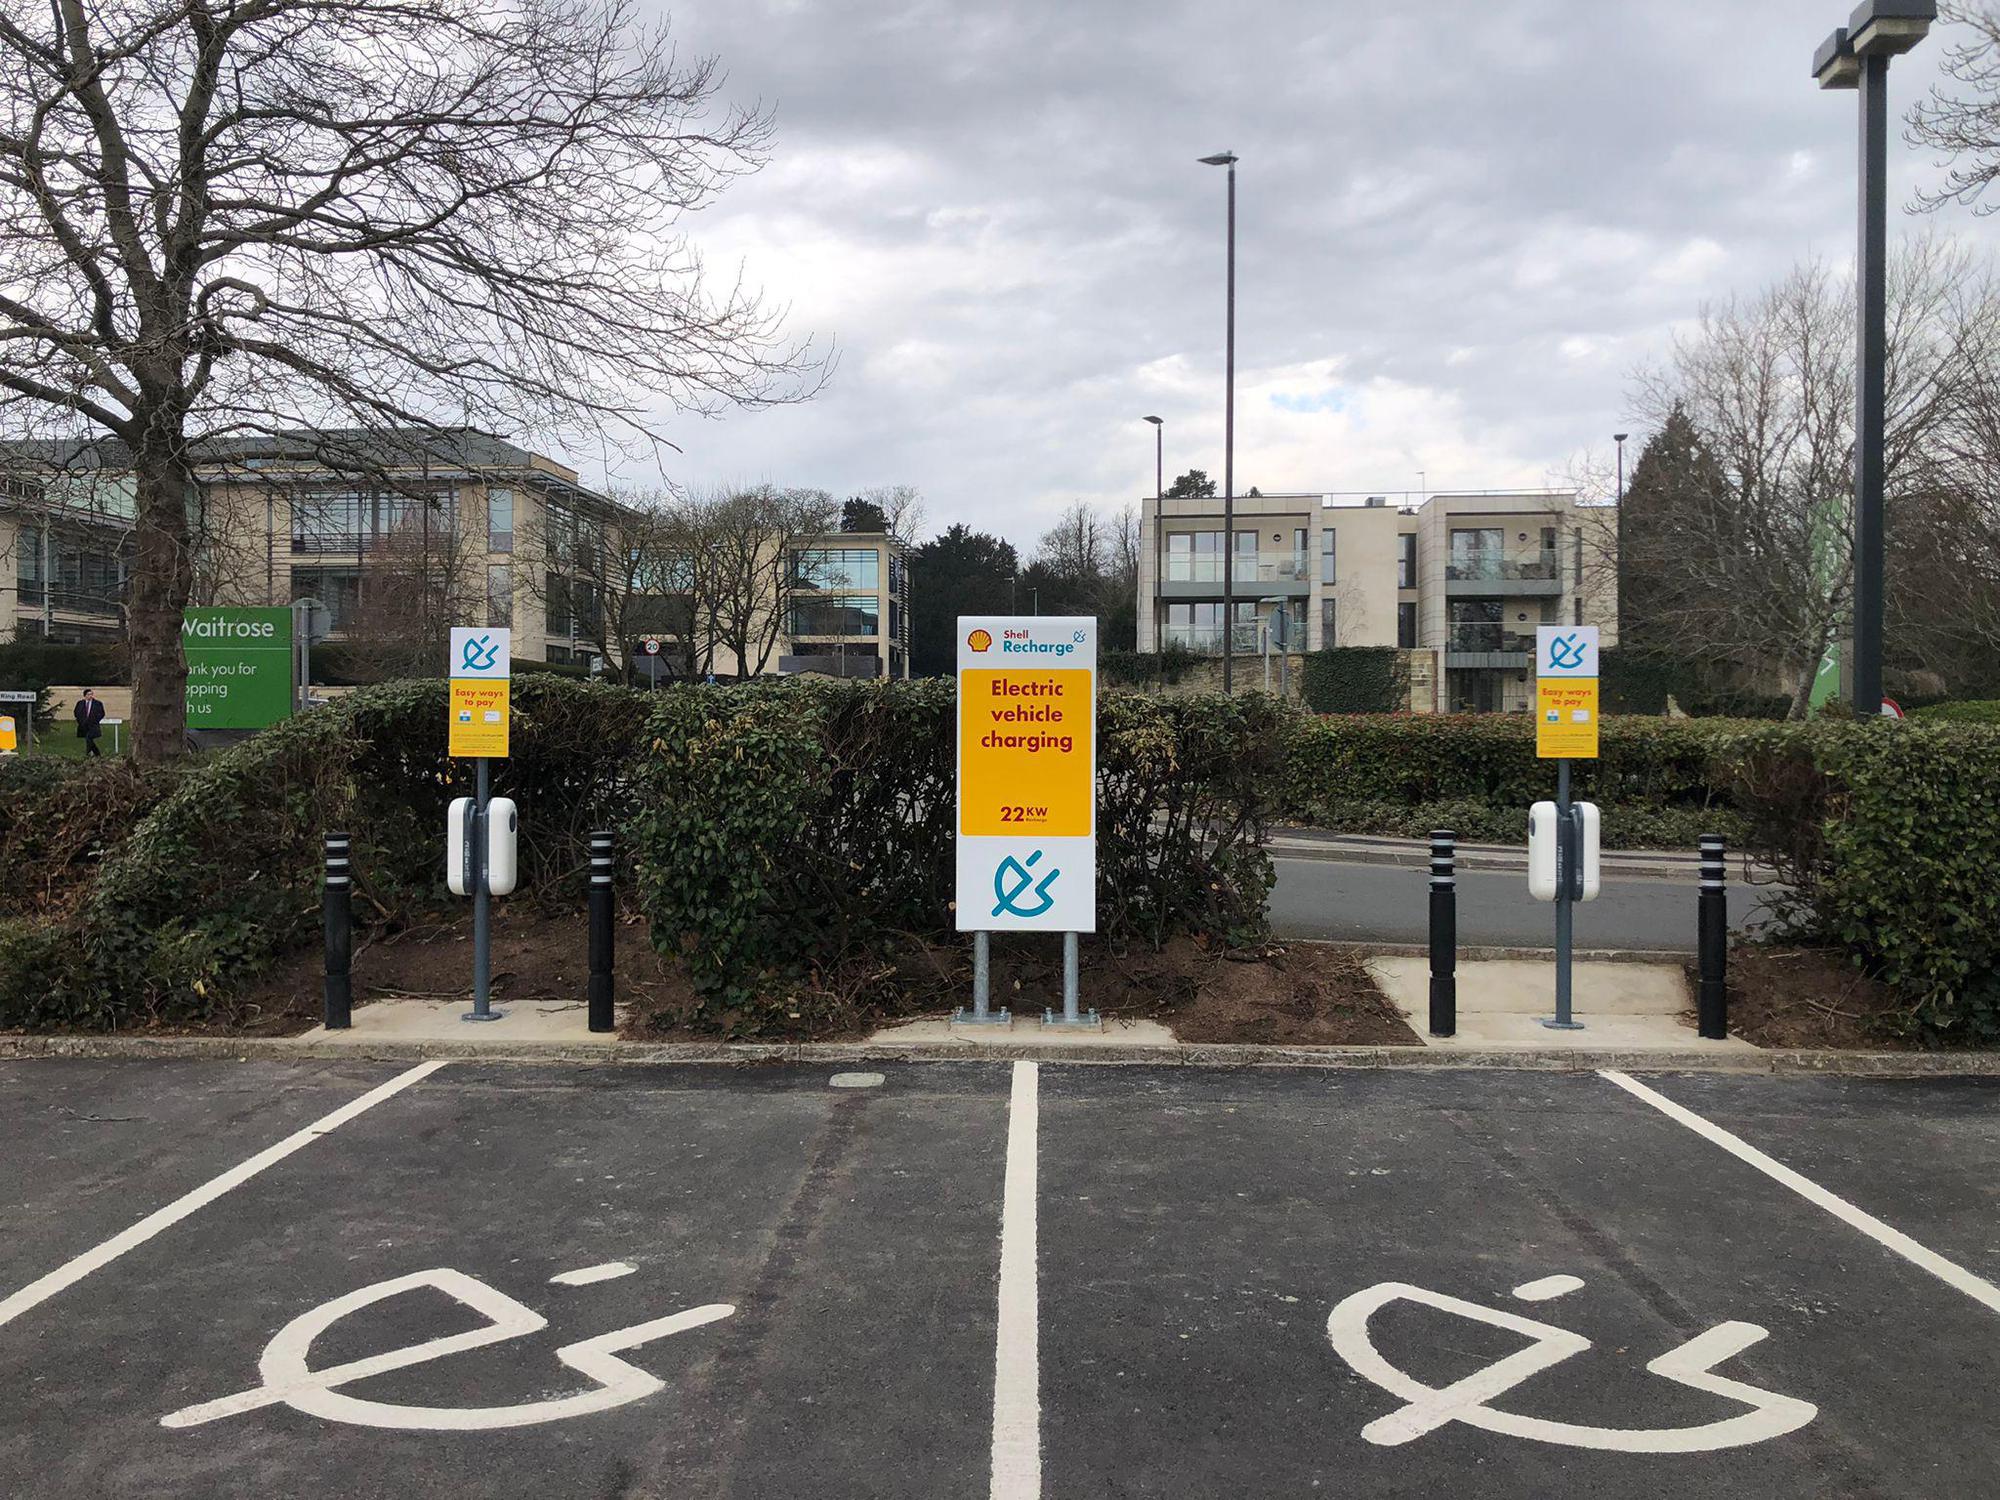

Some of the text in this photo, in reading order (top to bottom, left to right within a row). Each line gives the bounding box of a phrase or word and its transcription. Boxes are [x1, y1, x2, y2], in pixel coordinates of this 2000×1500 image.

[1003, 629, 1029, 639] Shell
[647, 643, 657, 651] 20
[1003, 639, 1074, 656] Recharge
[211, 665, 236, 679] you
[238, 662, 257, 675] for
[991, 678, 1064, 697] Electric
[1542, 687, 1592, 698] Easy ways
[455, 688, 504, 699] Easy ways
[477, 700, 495, 708] pay
[1564, 699, 1583, 707] pay
[198, 704, 212, 714] us
[990, 704, 1063, 722] vehicle
[981, 730, 1073, 753] charging
